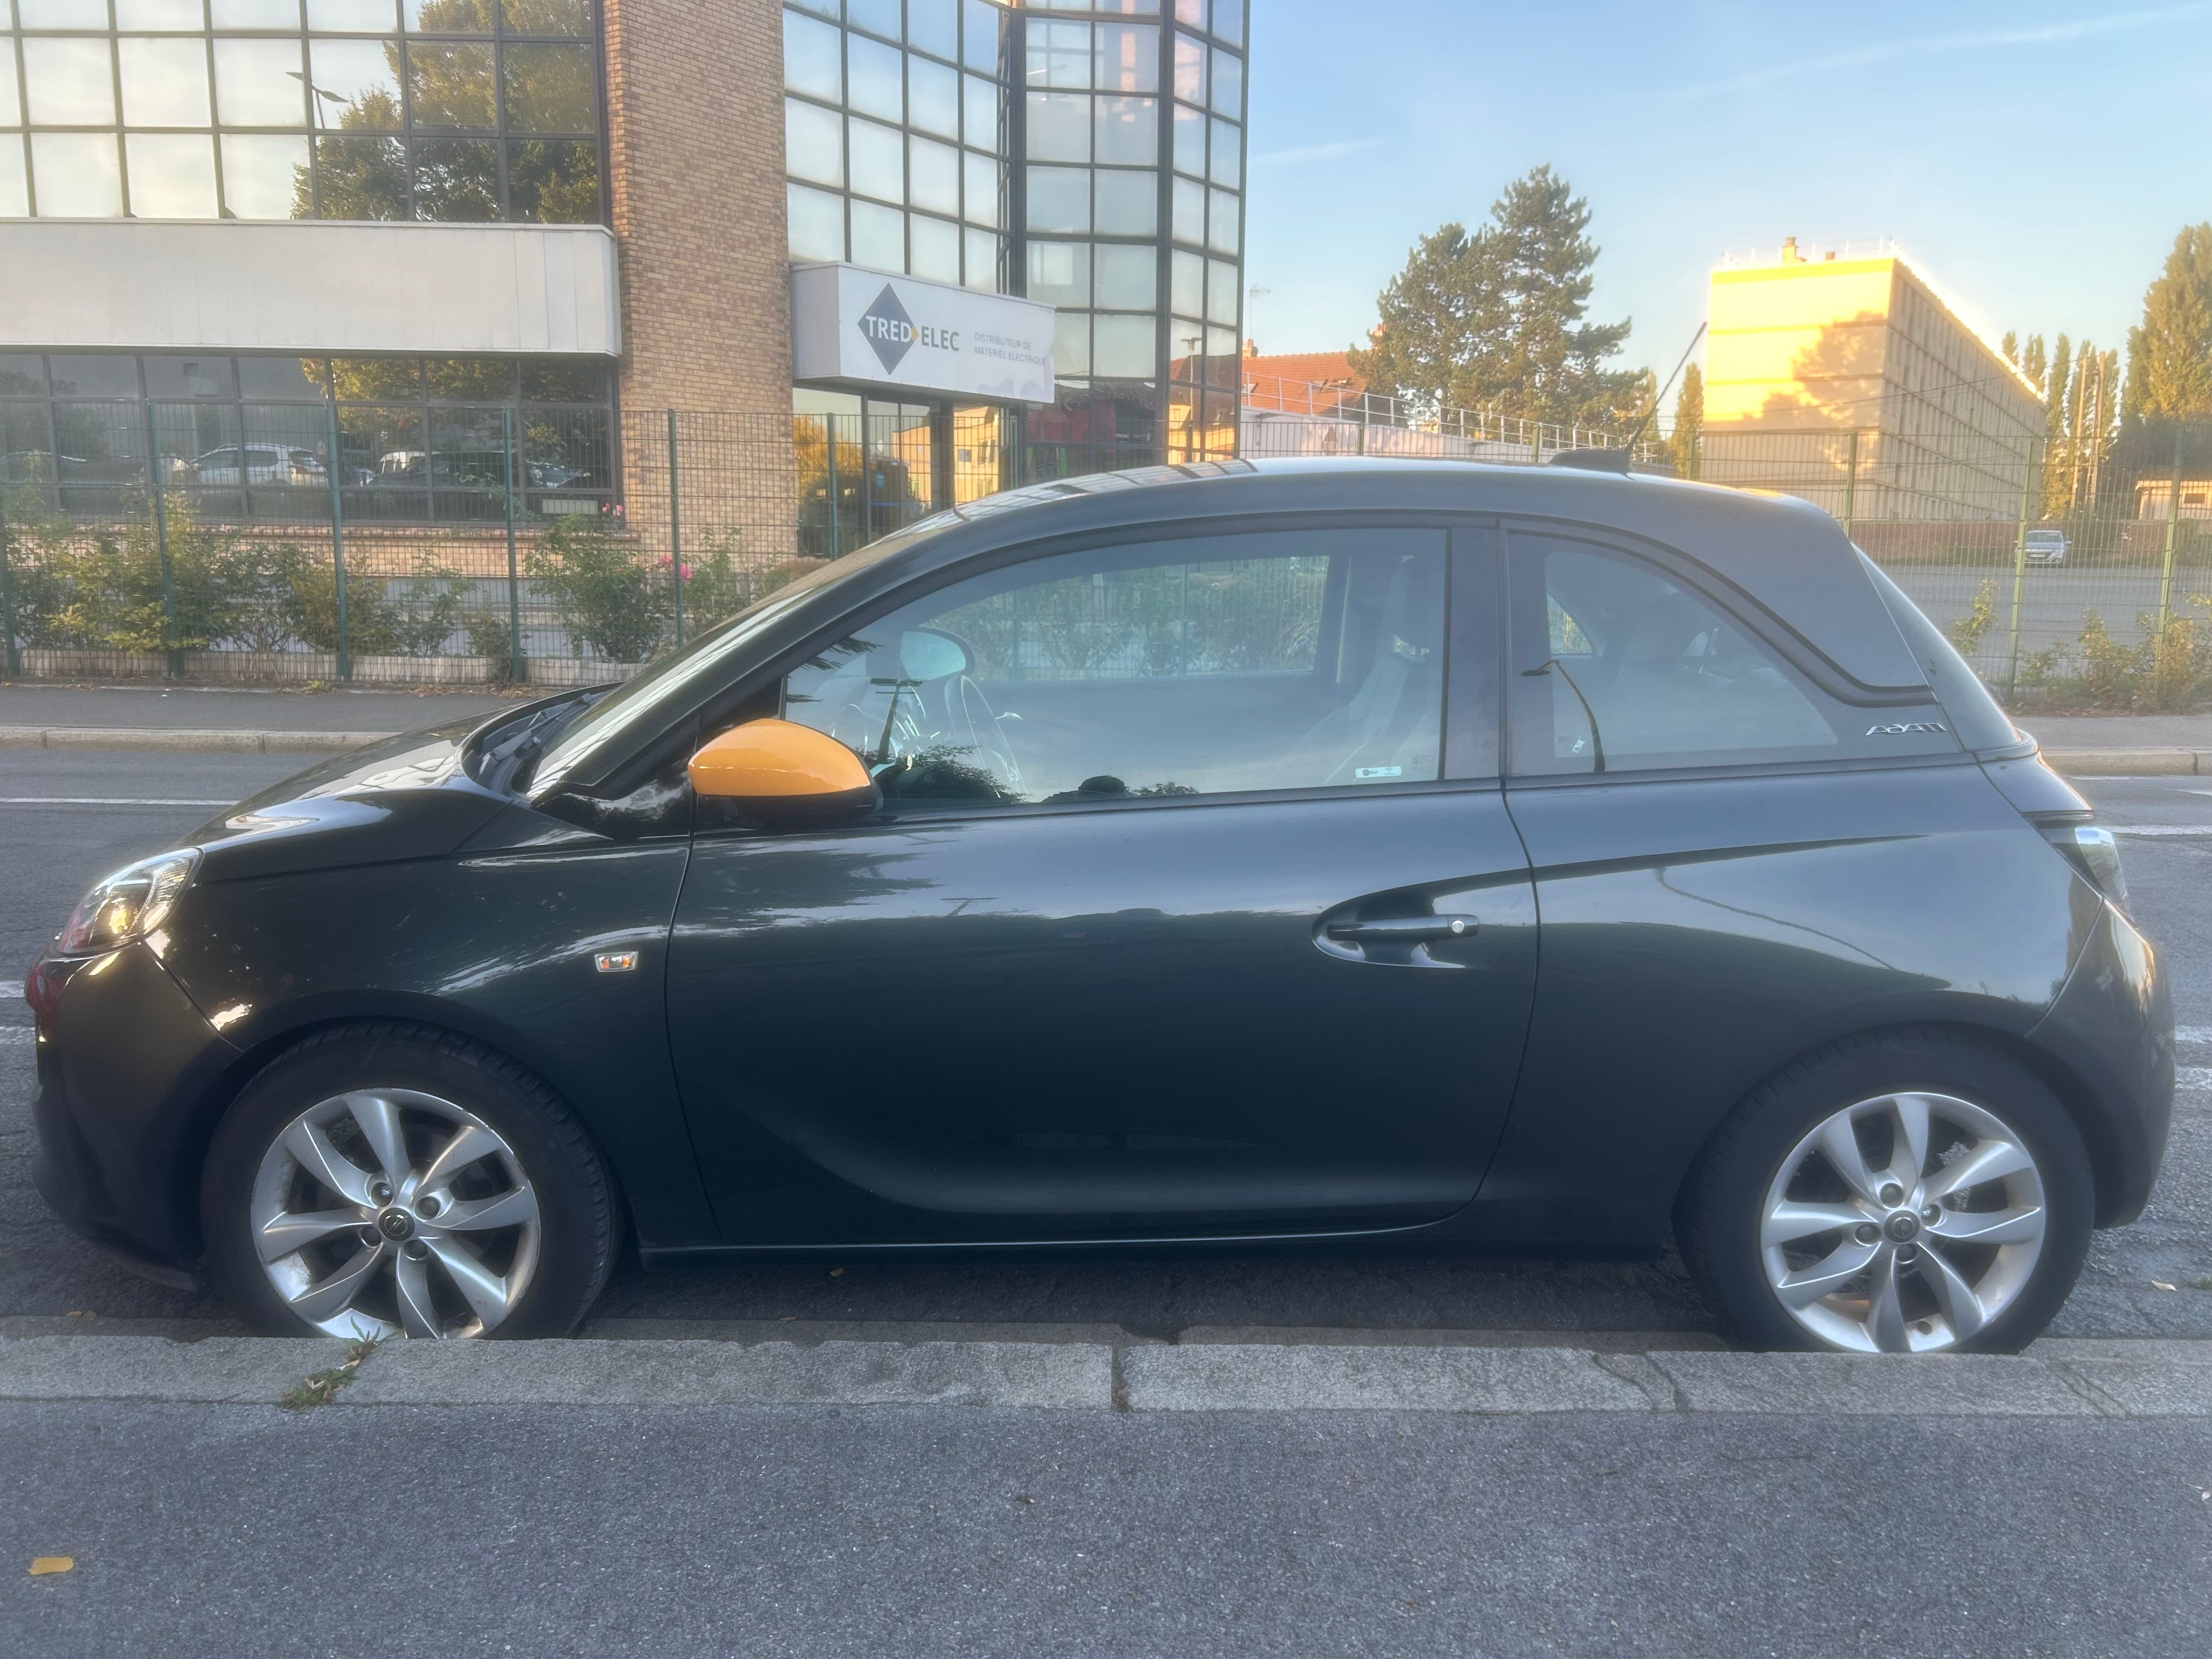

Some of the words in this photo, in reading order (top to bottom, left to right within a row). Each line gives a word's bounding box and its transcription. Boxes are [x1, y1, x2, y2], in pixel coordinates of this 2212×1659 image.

[866, 315, 912, 343] TRED
[921, 325, 960, 352] ELEC
[974, 332, 1021, 348] DISTRIBUTEUR
[1023, 341, 1031, 351] DE
[974, 346, 1007, 359] MATERIEL
[1008, 352, 1046, 366] ELECTRIQUE
[1865, 723, 1948, 736] ADAM
